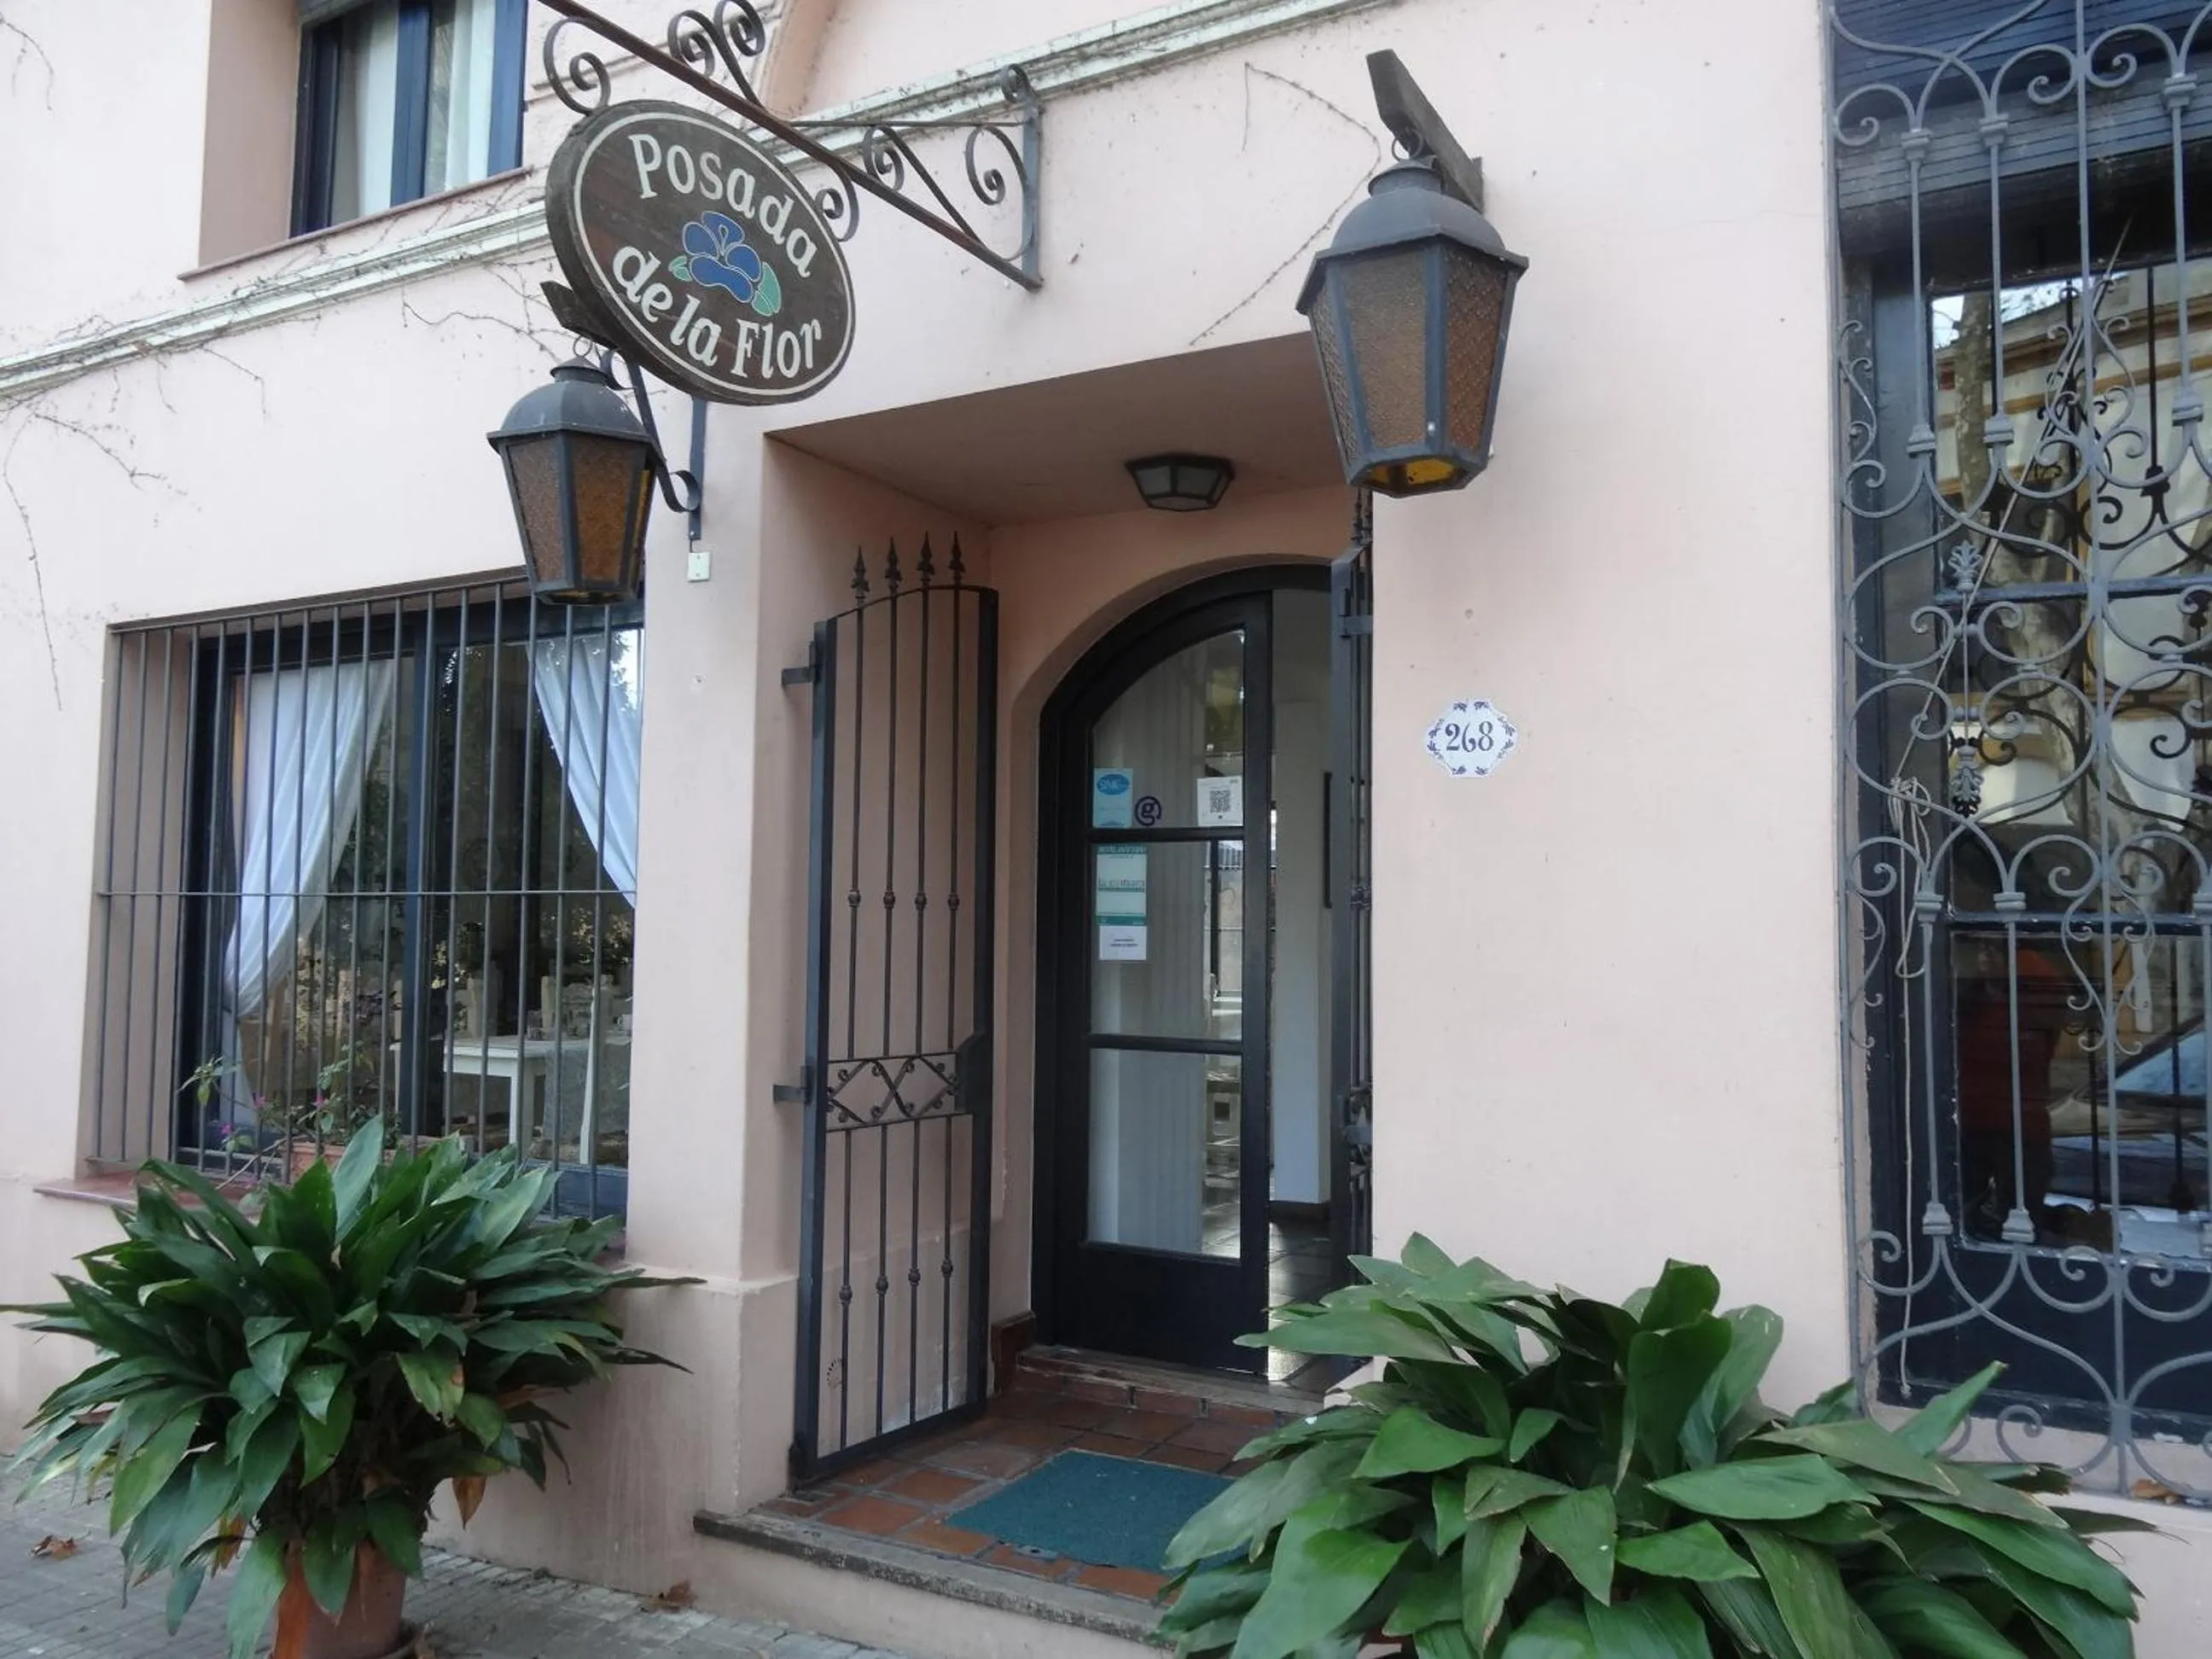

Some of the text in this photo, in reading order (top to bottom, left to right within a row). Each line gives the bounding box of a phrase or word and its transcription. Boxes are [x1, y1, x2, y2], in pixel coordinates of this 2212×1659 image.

[628, 134, 818, 277] Posada
[613, 246, 822, 378] de la Flor
[1445, 720, 1494, 753] 268
